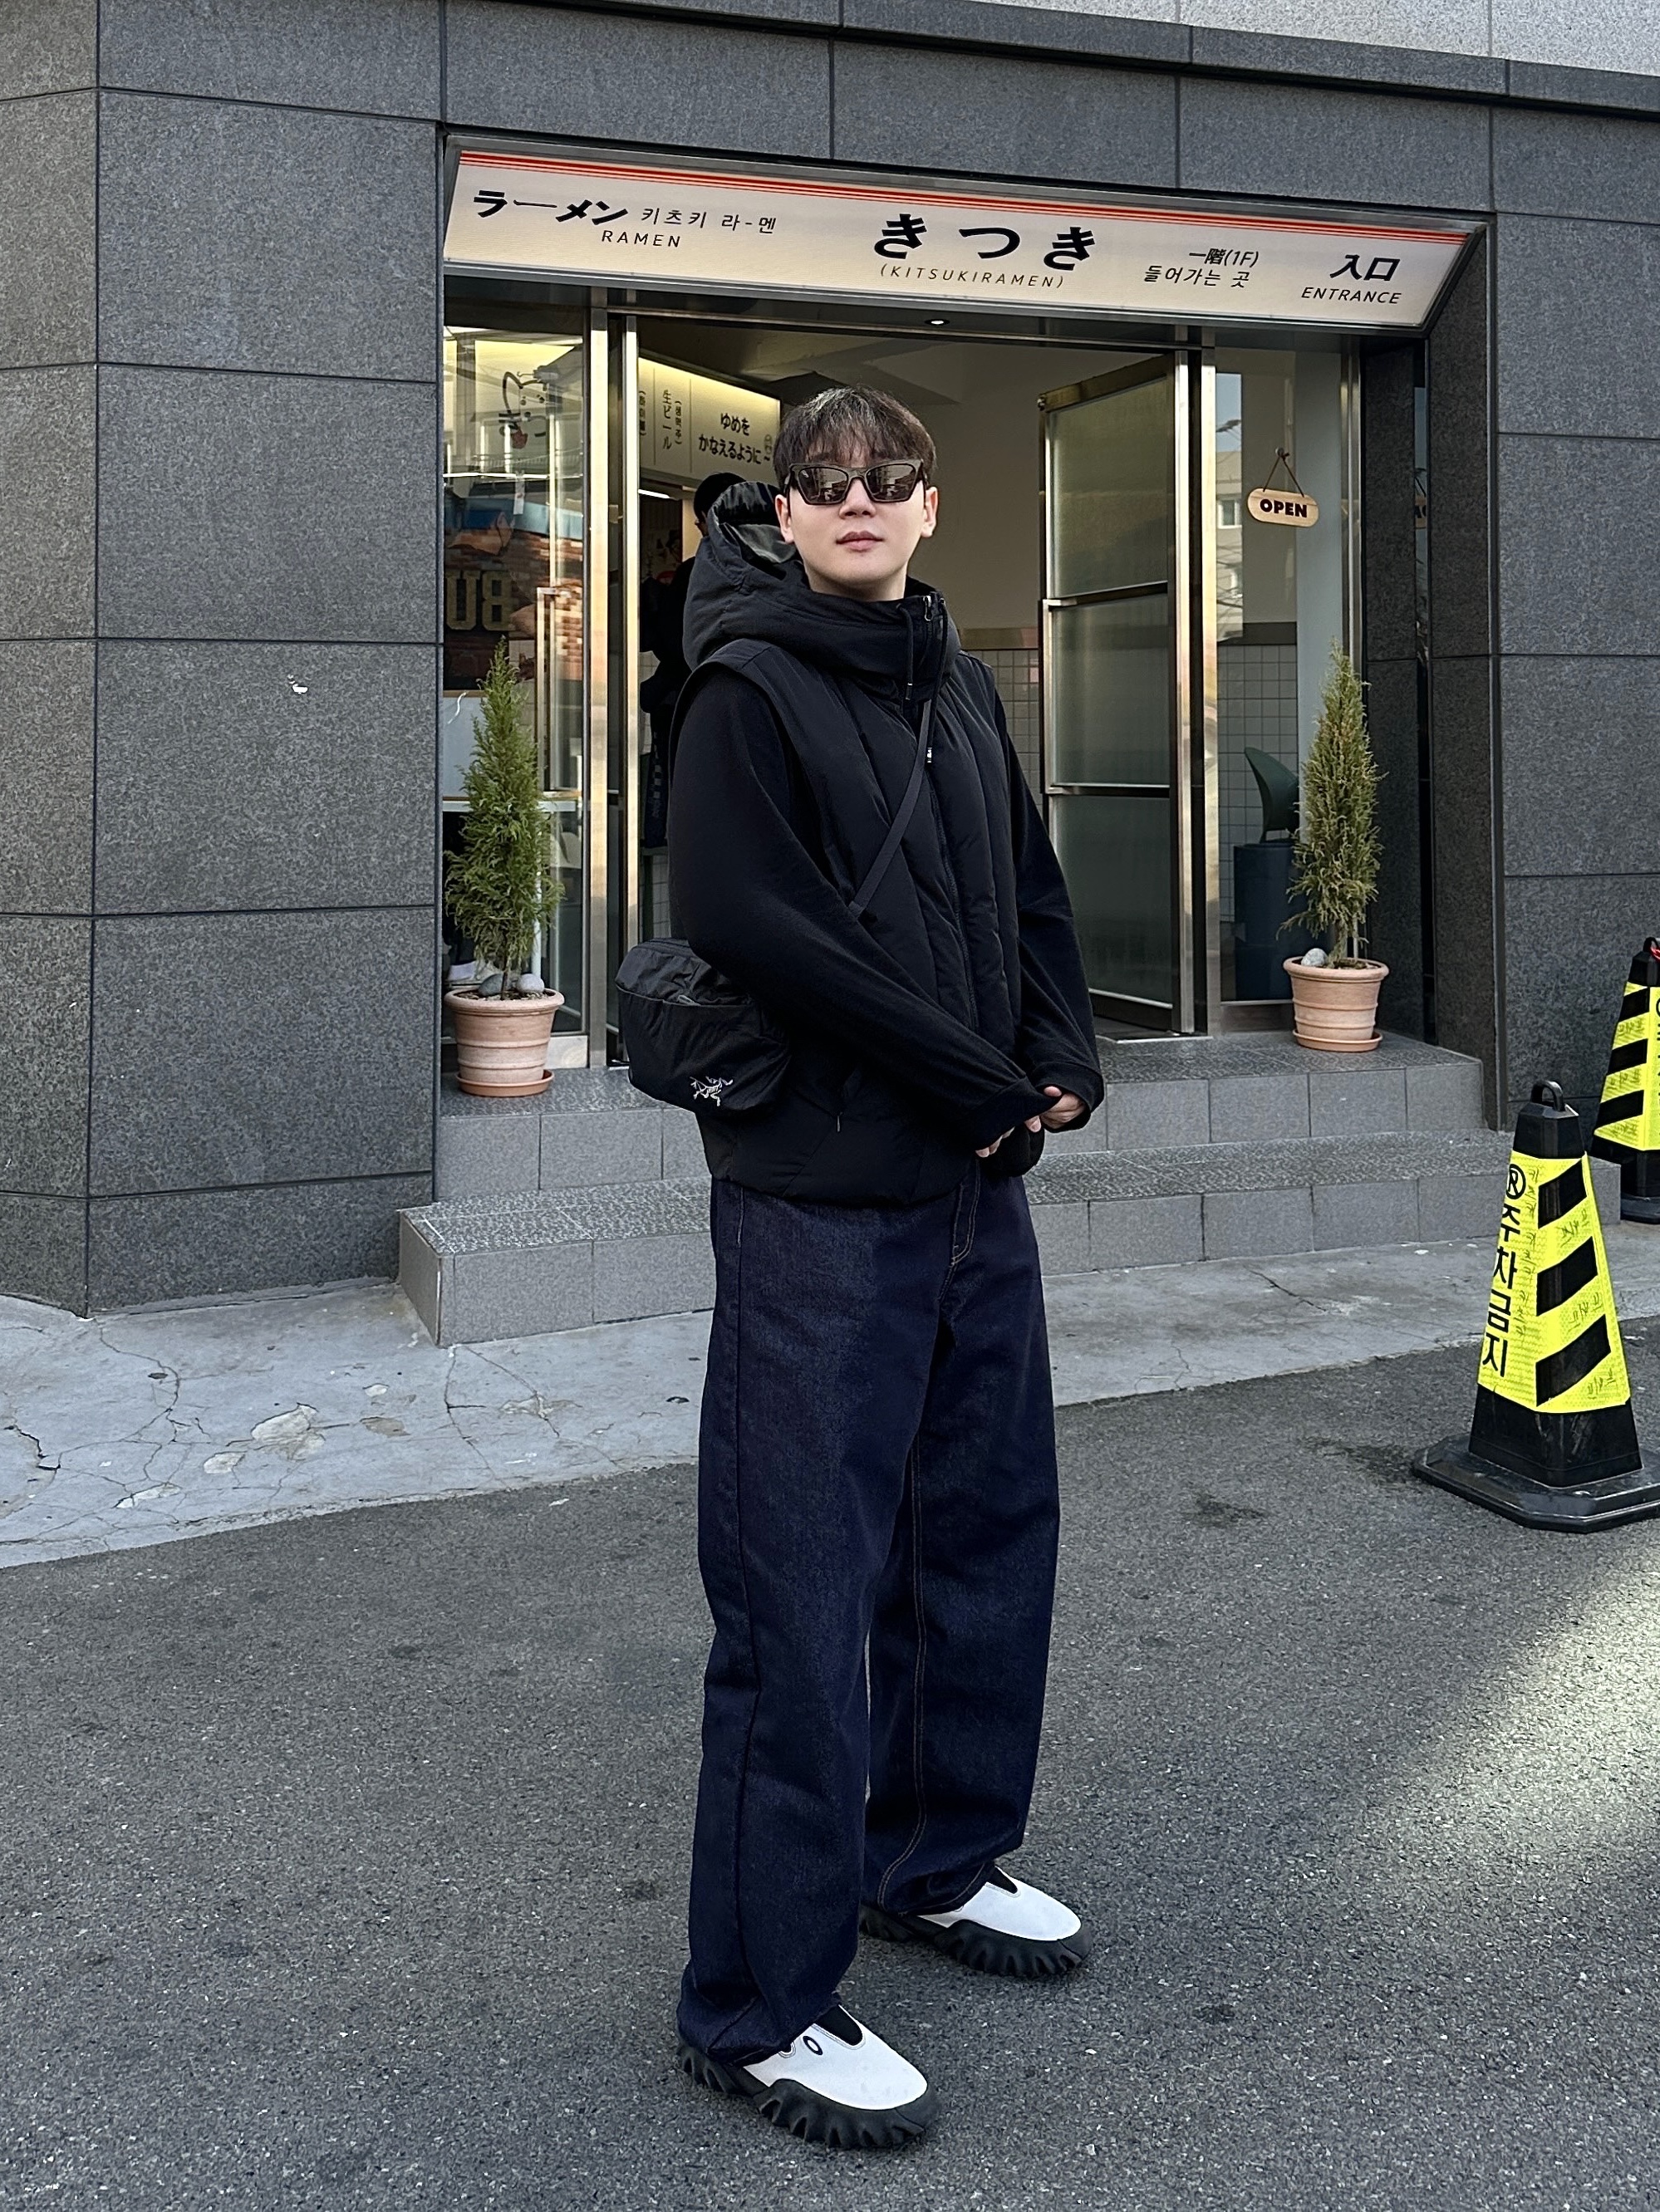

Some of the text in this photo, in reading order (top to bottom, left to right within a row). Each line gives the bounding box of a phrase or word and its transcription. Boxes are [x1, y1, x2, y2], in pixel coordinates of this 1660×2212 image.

[473, 190, 628, 225] ラーメン
[641, 208, 777, 234] 키츠키 라-멘
[601, 229, 681, 248] RAMEN
[873, 213, 1096, 272] きつき
[1188, 248, 1260, 268] 一階(1F)
[1329, 253, 1401, 282] 入口
[880, 262, 1064, 289] (KITSUKIRAMEN)
[1143, 265, 1250, 288] 들어가는 곳
[1301, 287, 1402, 305] ENTRANCE
[719, 412, 750, 436] ゆめを
[1260, 498, 1308, 518] OPEN
[1482, 1203, 1521, 1377] 주차금지
